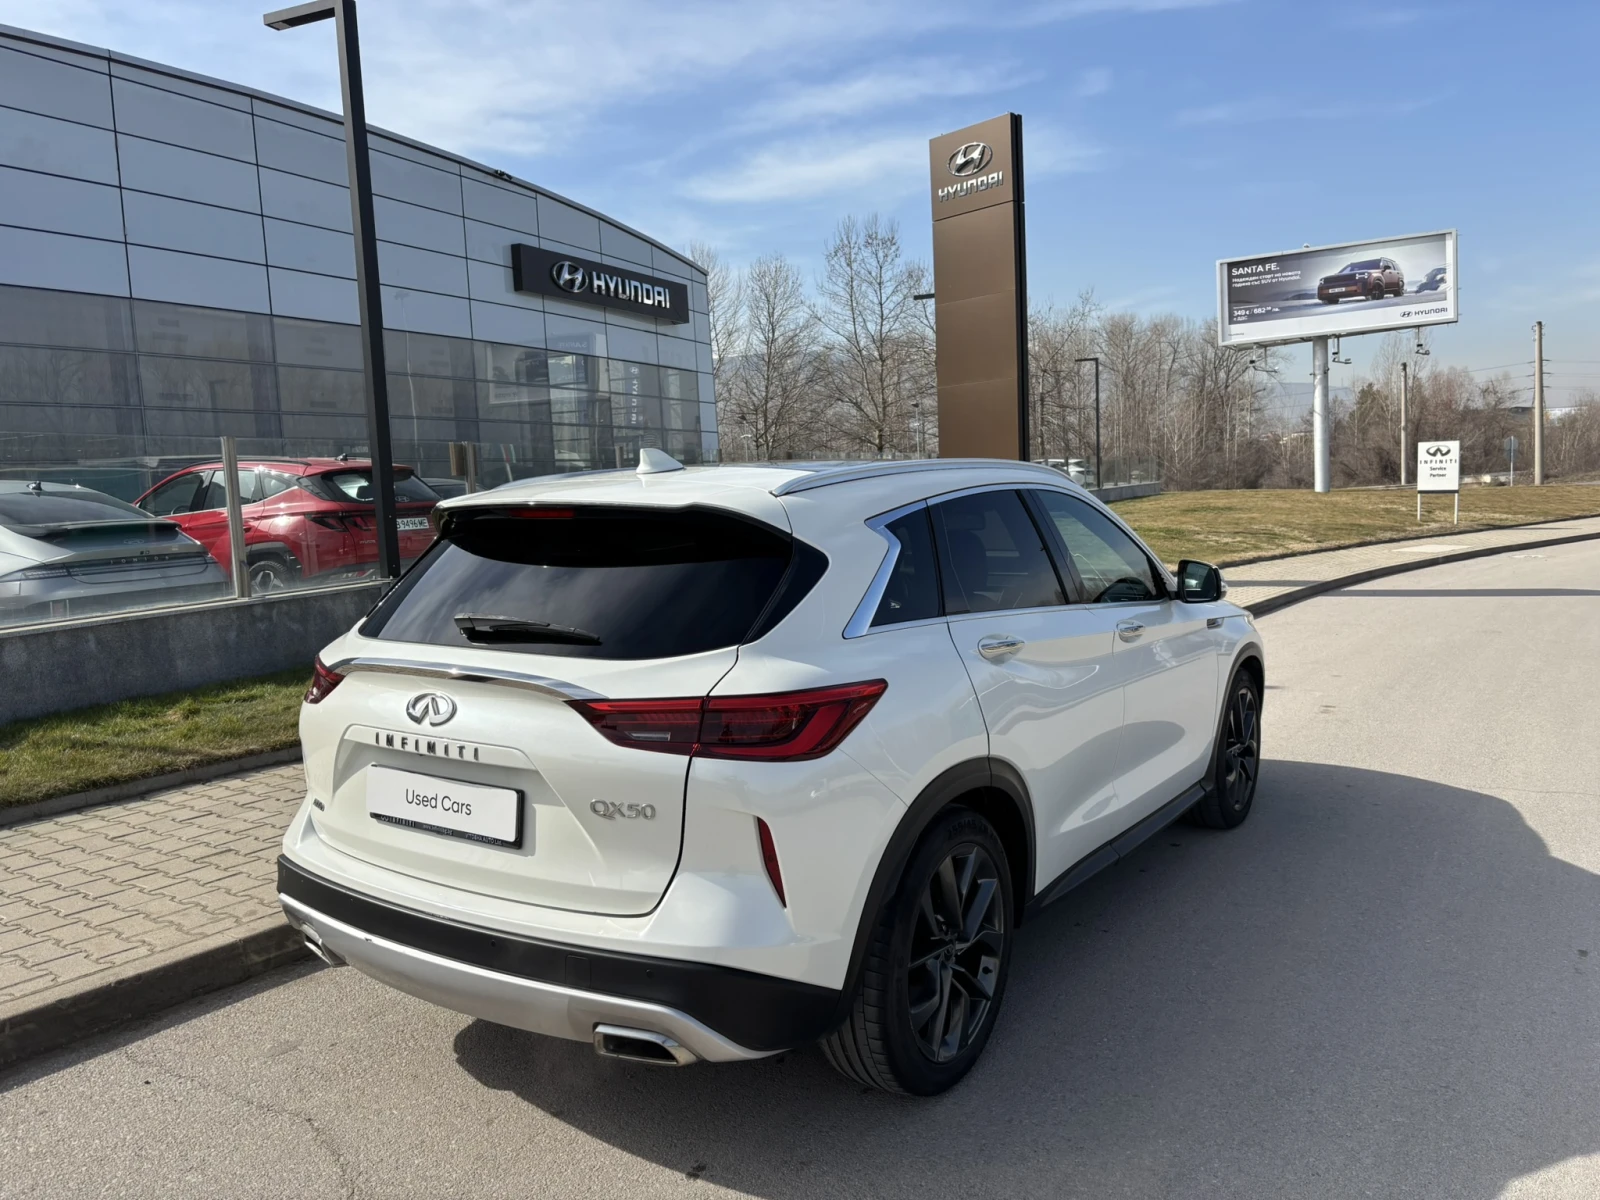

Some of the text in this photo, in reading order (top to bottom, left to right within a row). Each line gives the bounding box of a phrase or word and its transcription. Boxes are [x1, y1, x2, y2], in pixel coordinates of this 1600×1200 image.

[938, 170, 1004, 202] HYUNDAI
[1232, 262, 1280, 276] SANTA FE.
[592, 271, 670, 309] HYUNDAI
[1414, 307, 1448, 316] HYUNDAI
[375, 732, 481, 762] INFINITI
[405, 788, 472, 816] Used Cars
[589, 798, 657, 821] QX50
